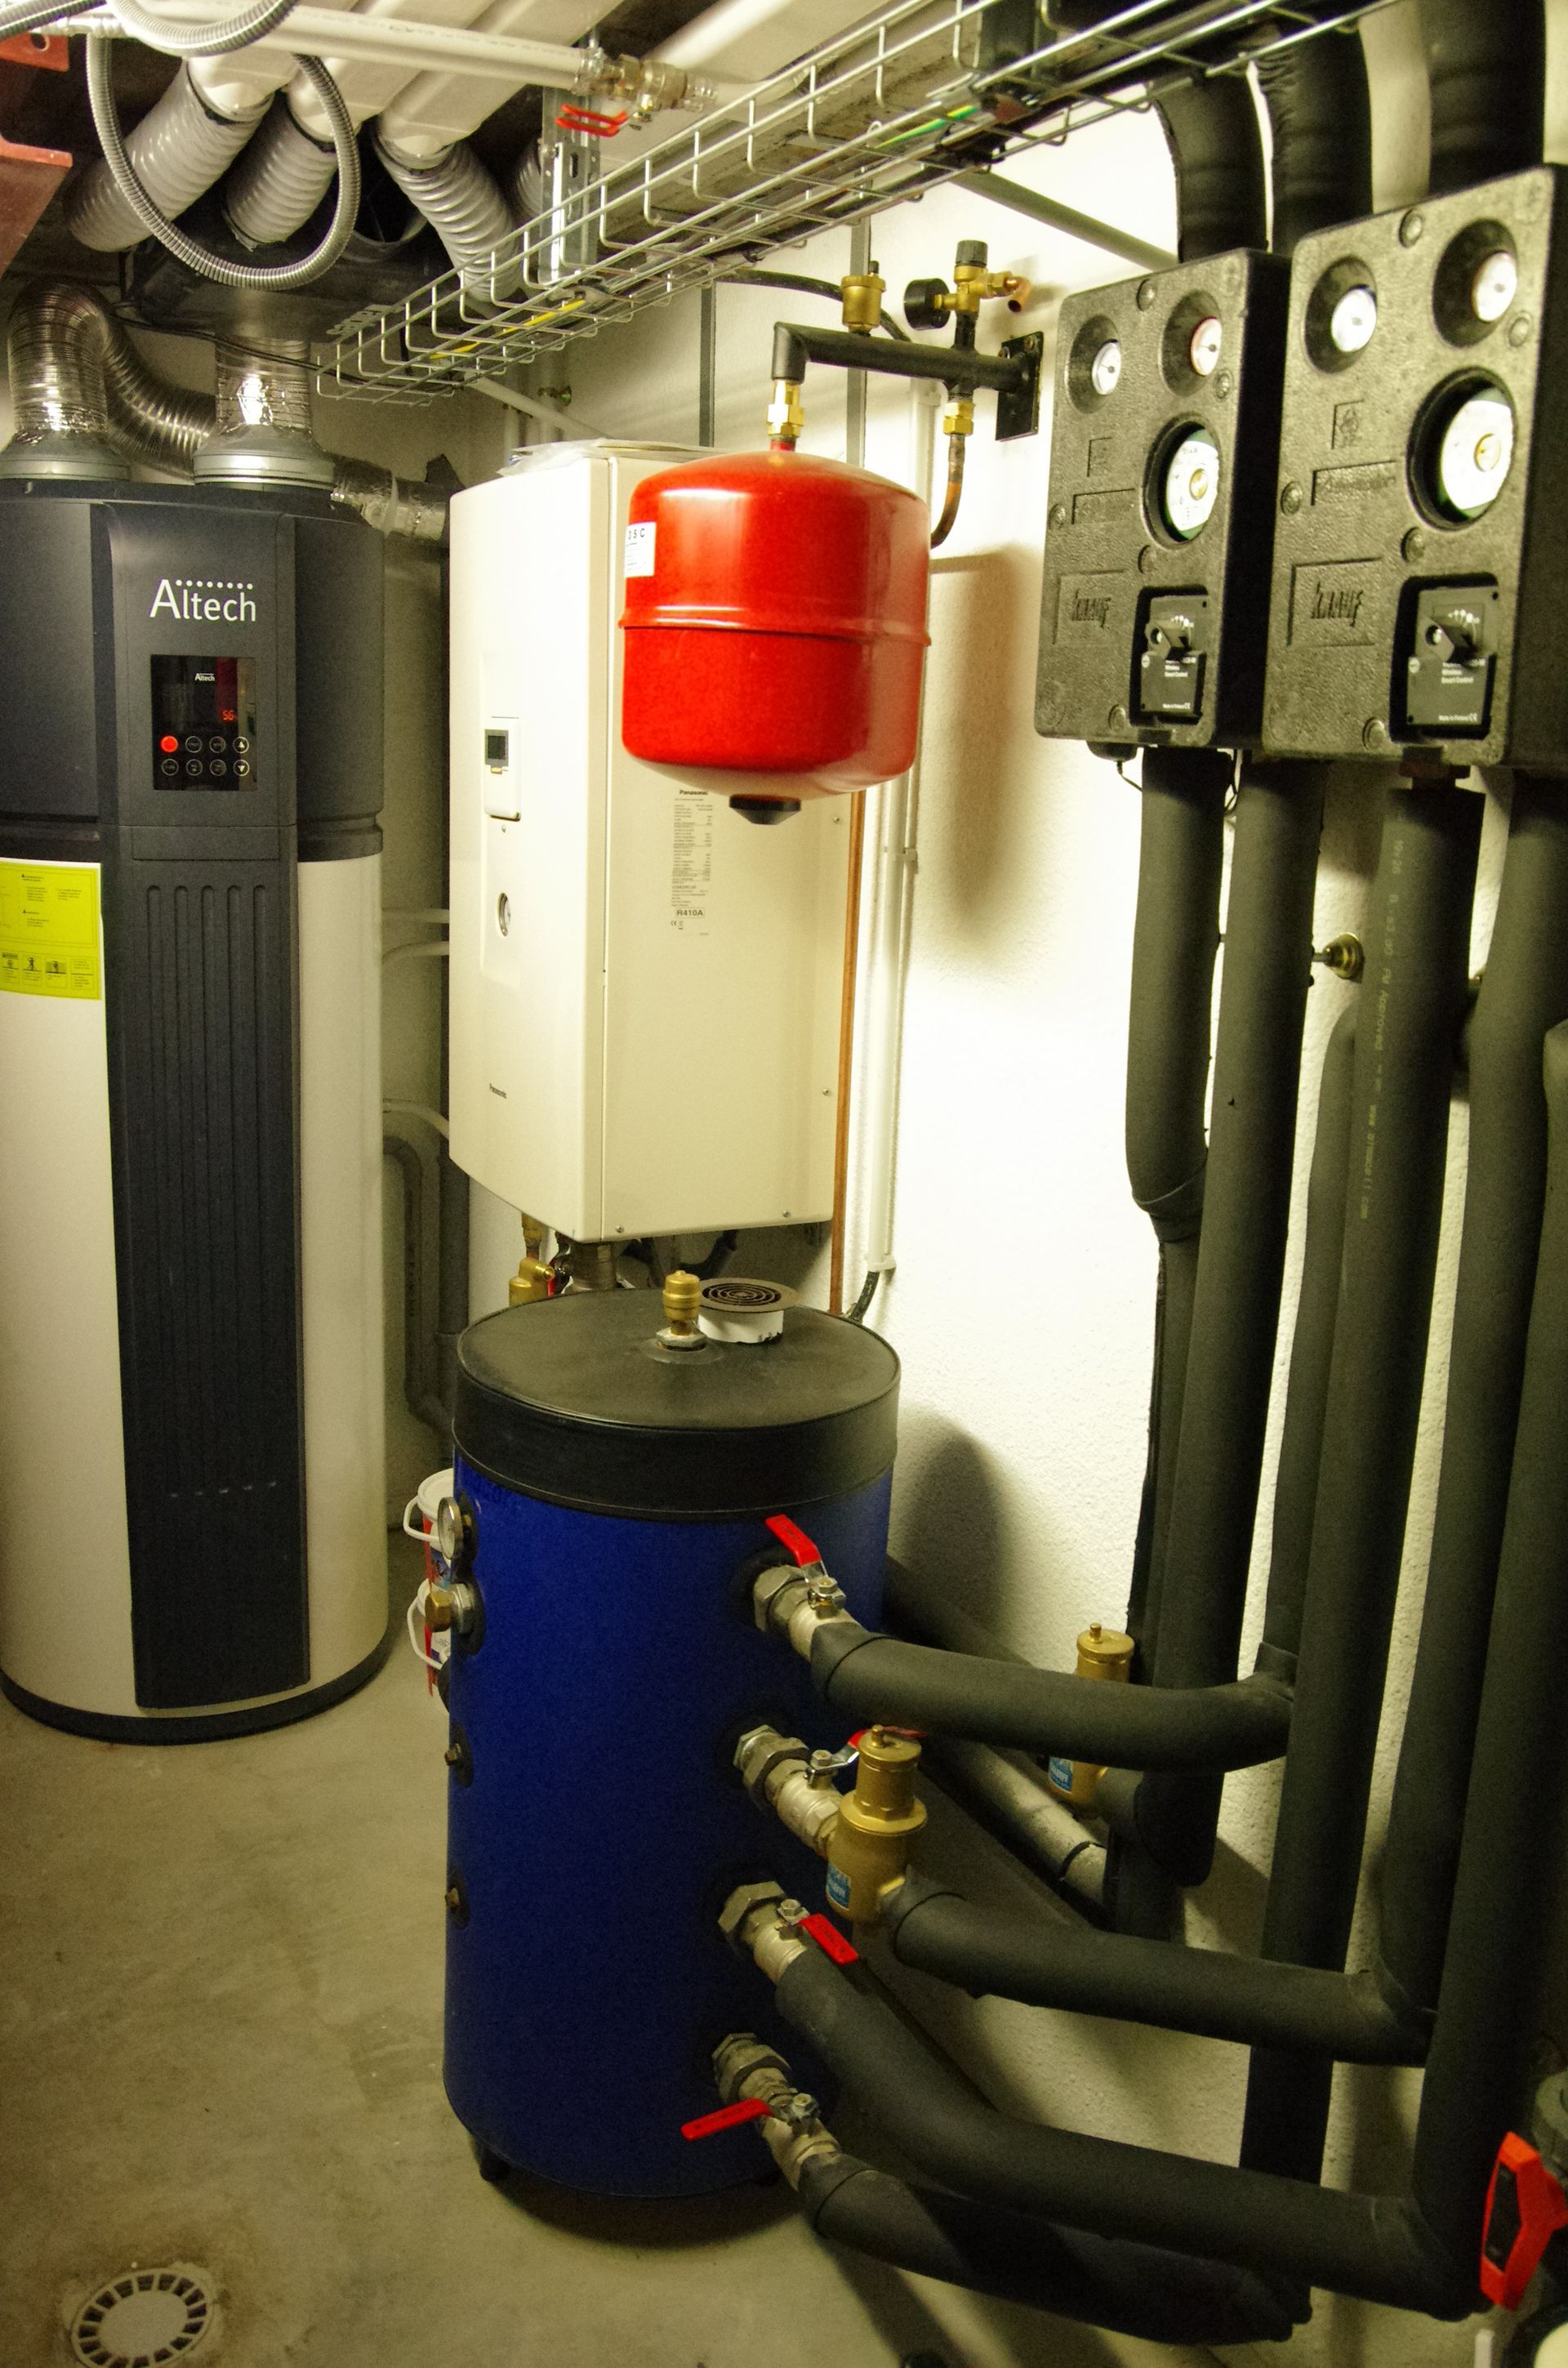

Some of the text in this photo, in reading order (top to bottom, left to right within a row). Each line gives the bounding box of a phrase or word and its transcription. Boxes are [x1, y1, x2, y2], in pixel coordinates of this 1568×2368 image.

[149, 579, 256, 622] Altech
[194, 672, 216, 681] Altech
[676, 908, 704, 917] R410A
[1374, 989, 1389, 1051] Approved
